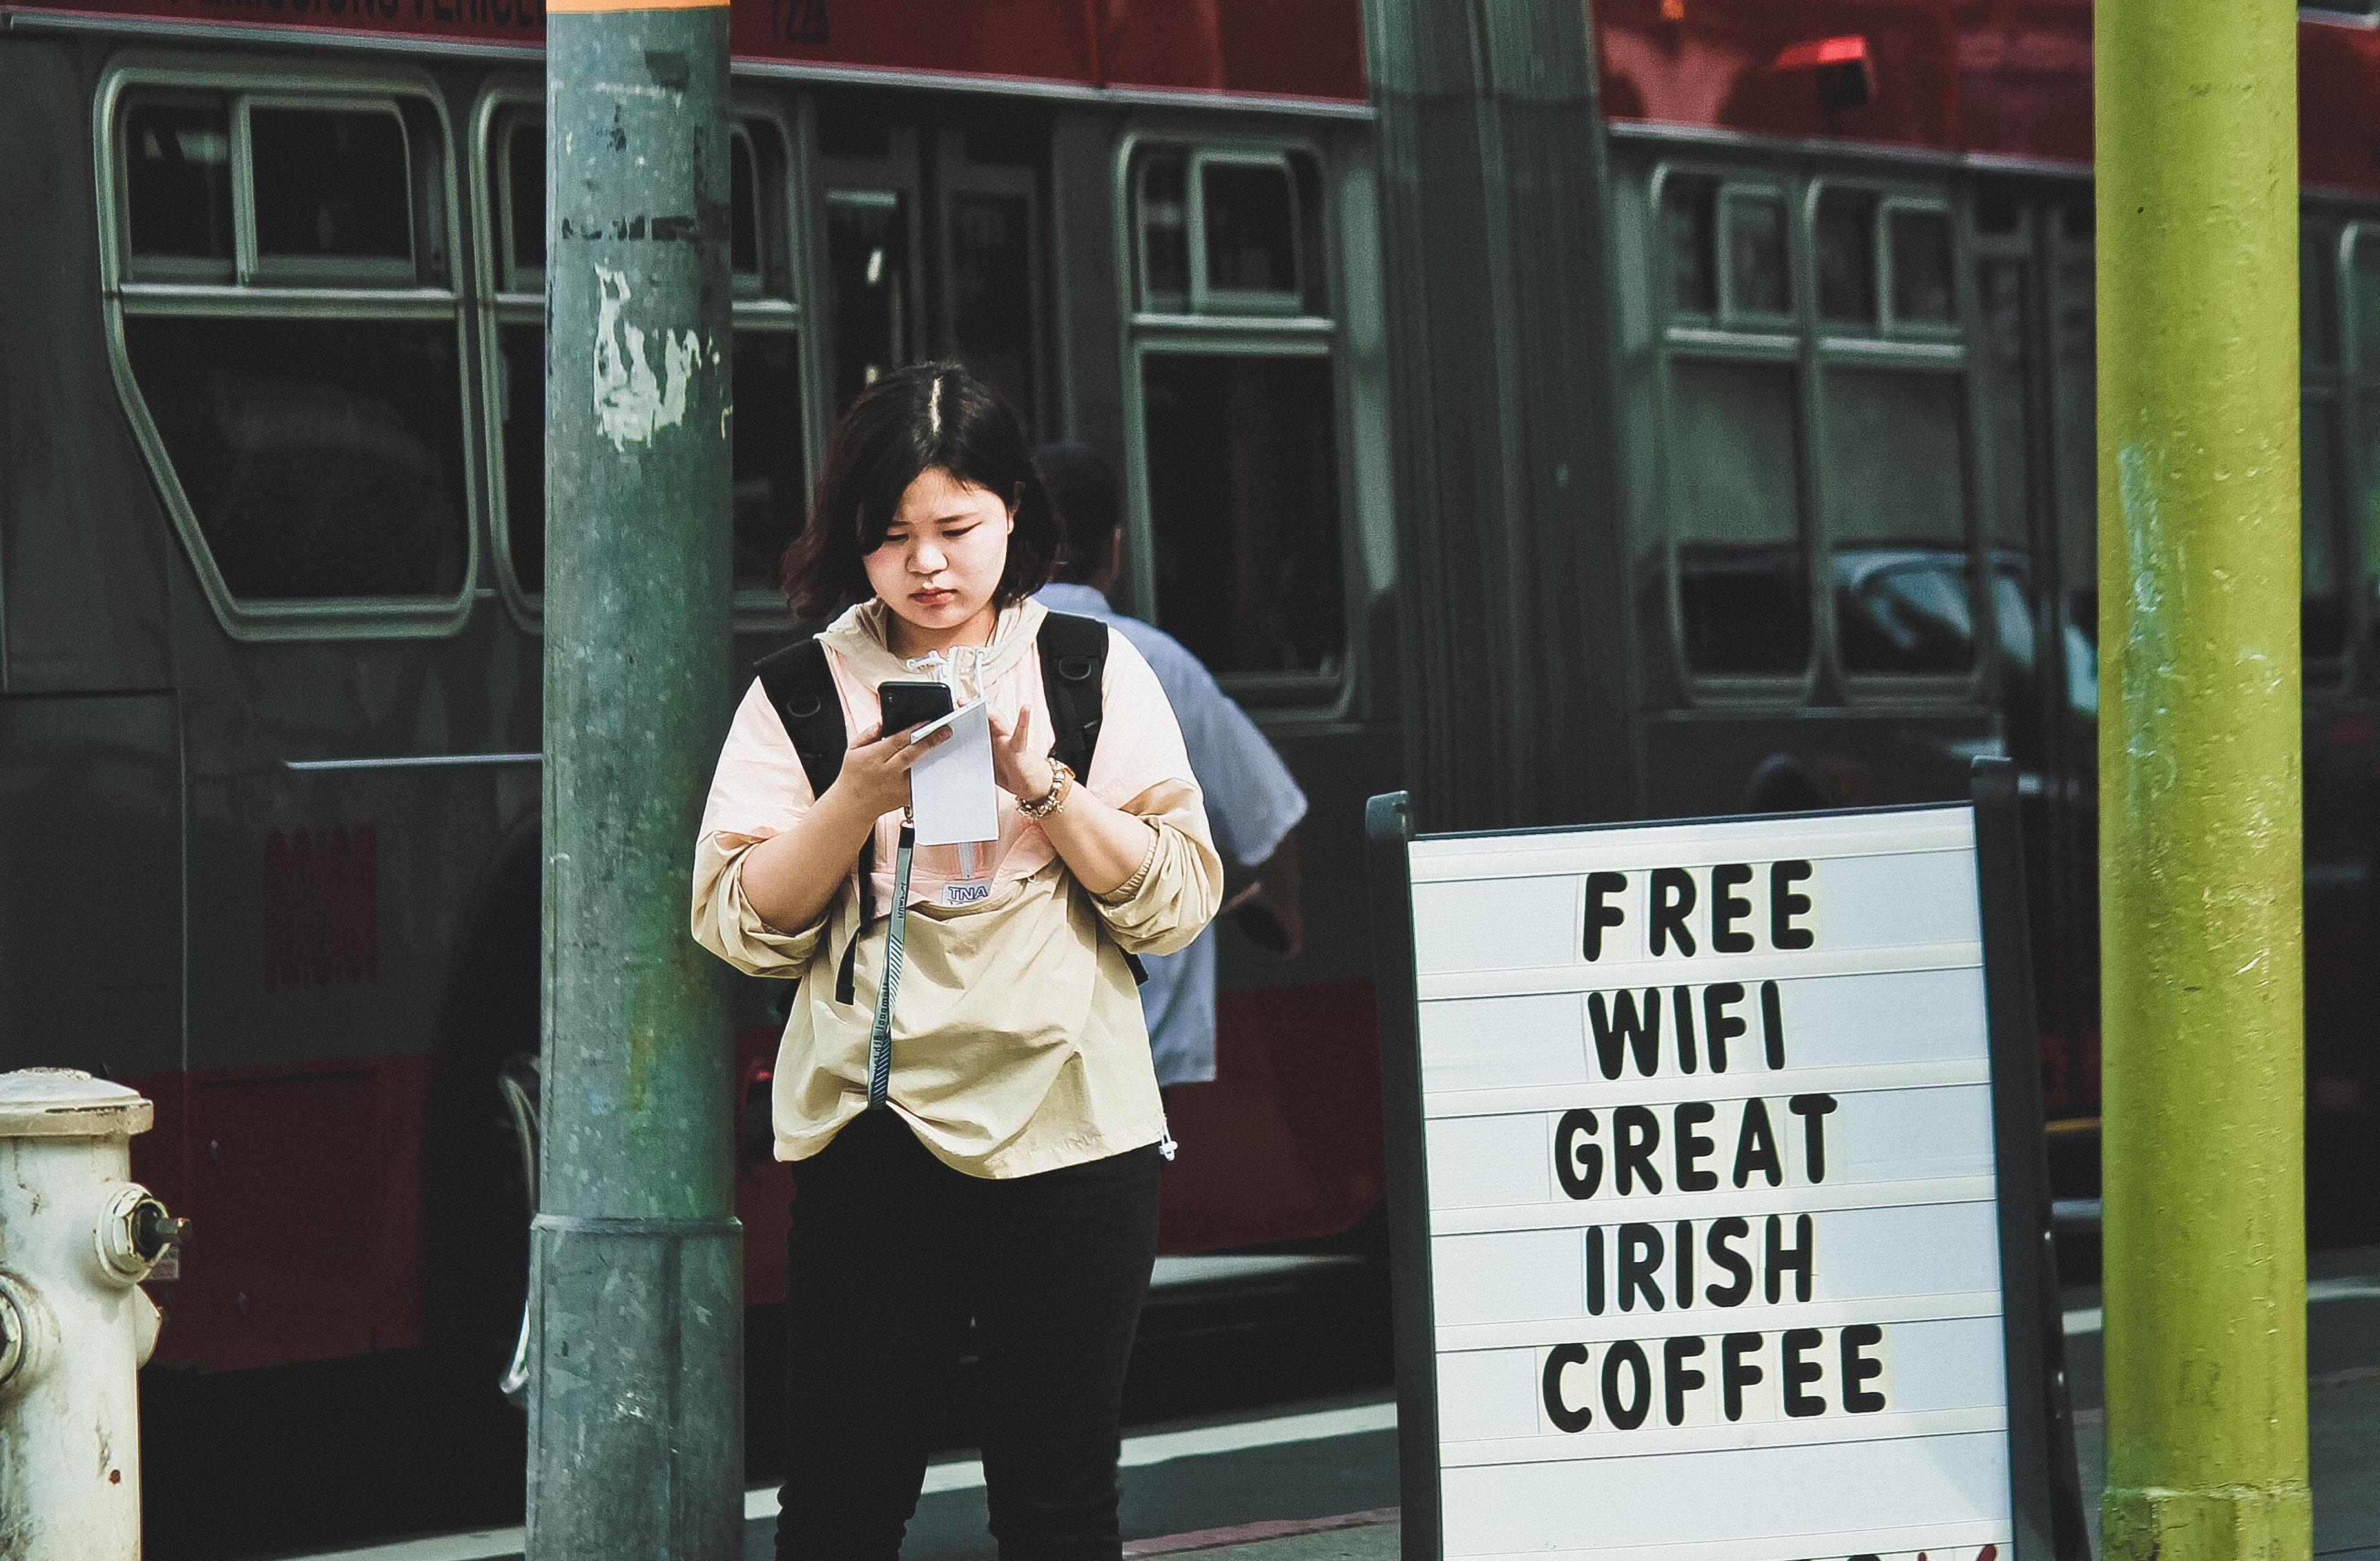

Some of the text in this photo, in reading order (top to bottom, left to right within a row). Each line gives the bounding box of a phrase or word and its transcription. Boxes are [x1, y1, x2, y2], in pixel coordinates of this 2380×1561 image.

[948, 886, 988, 900] TNA
[1584, 860, 1813, 961] FREE
[1588, 980, 1784, 1080] WIFI
[1556, 1094, 1837, 1199] GREAT
[1587, 1214, 1812, 1315] IRISH
[1543, 1324, 1885, 1433] COFFEE
